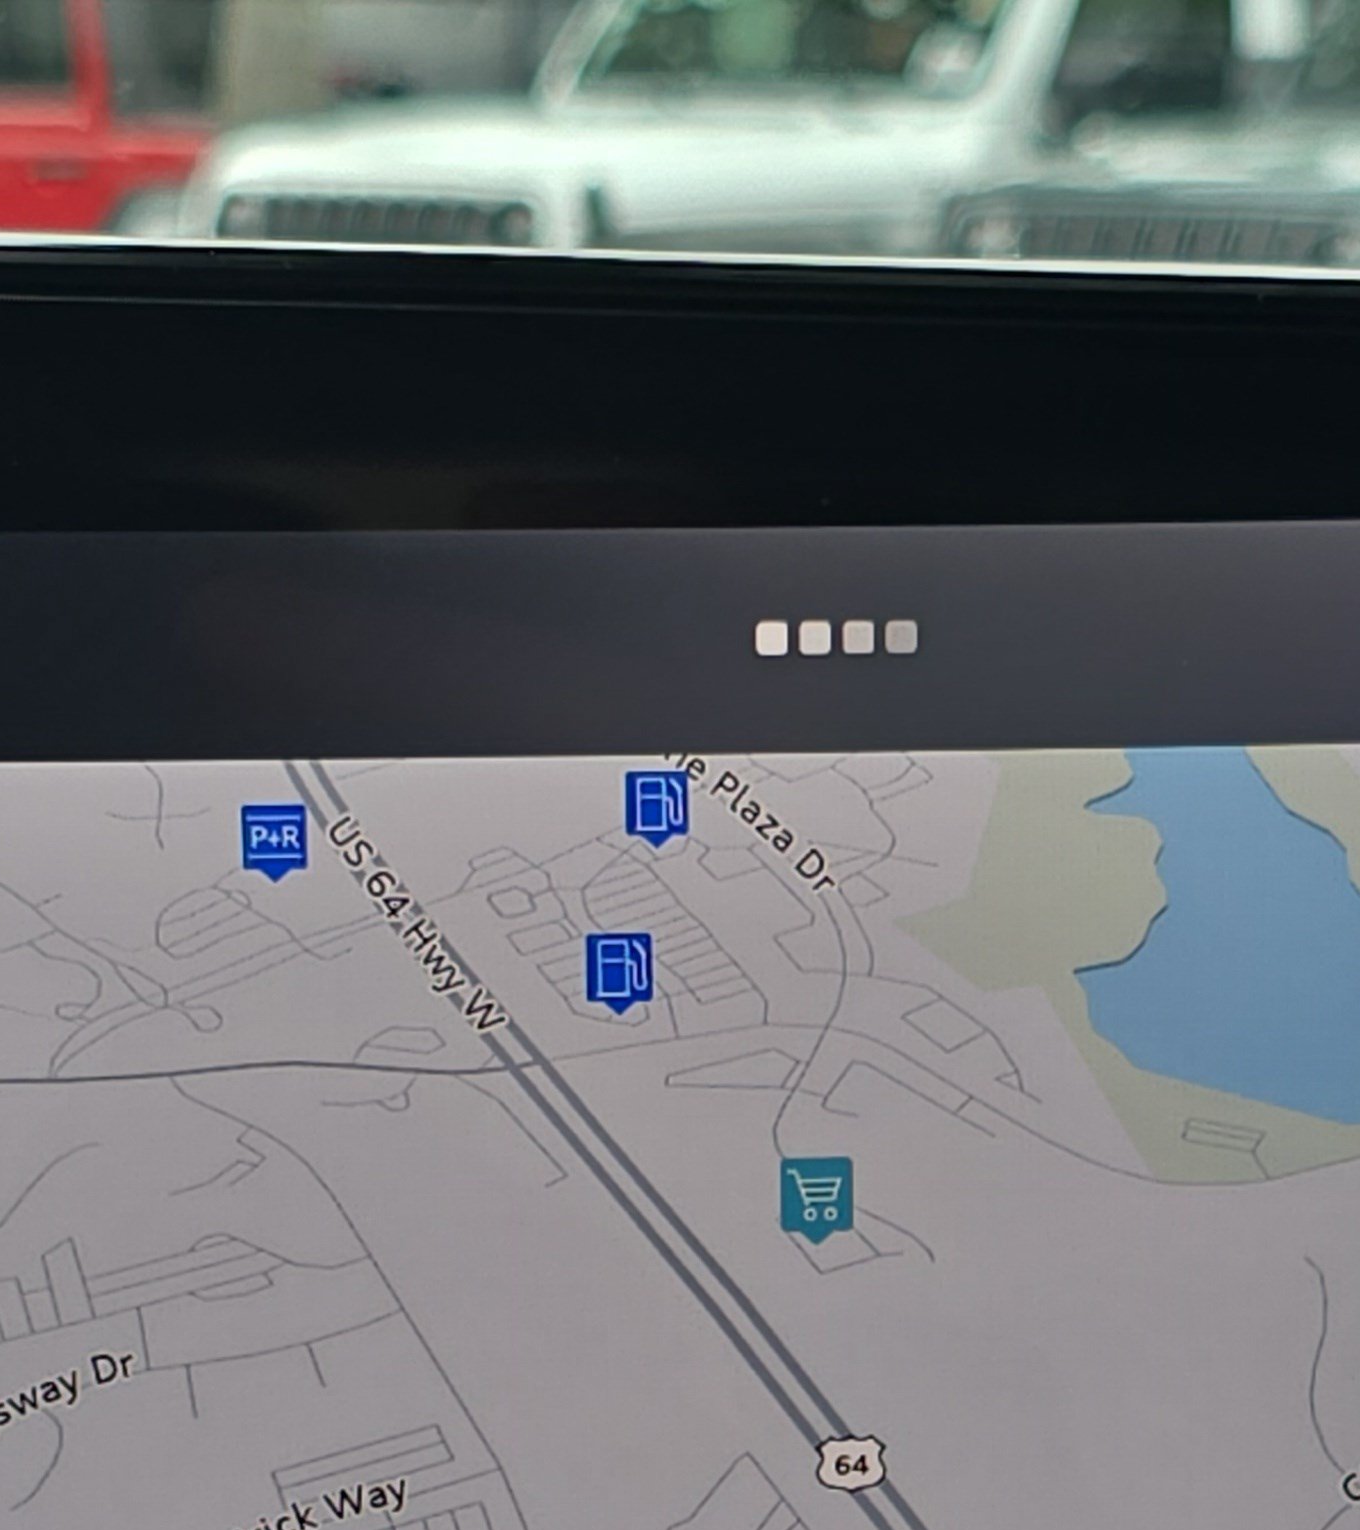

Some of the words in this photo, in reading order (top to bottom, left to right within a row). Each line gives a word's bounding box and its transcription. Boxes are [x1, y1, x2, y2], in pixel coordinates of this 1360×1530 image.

[250, 825, 301, 849] P+R
[710, 771, 794, 853] Plaza
[794, 848, 836, 891] Dr
[329, 816, 373, 867] US
[366, 871, 410, 918] 64
[402, 918, 465, 993] Hwy
[465, 988, 506, 1030] W
[91, 1354, 133, 1385] Dr
[834, 1454, 870, 1476] 64
[324, 1479, 407, 1520] Way
